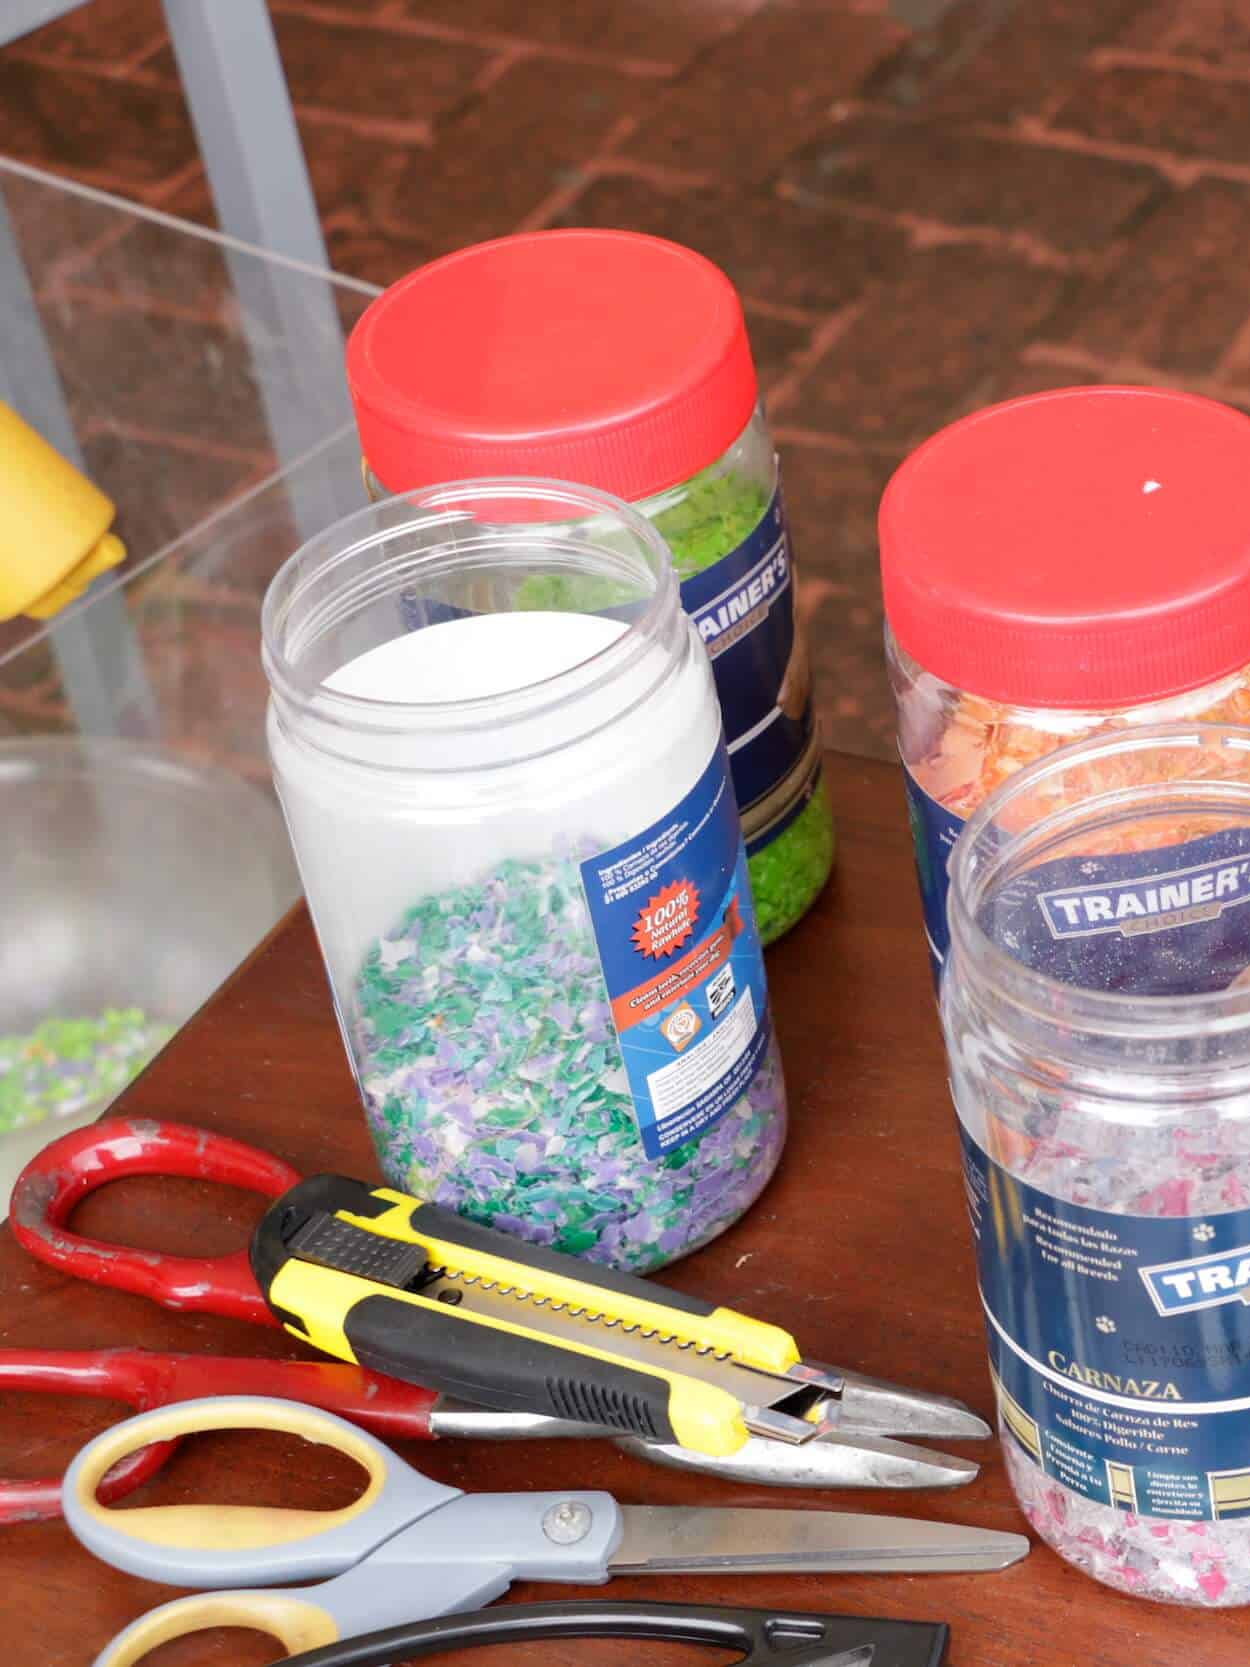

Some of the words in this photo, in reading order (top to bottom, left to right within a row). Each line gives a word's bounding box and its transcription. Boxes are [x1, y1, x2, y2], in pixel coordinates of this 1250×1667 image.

[644, 889, 689, 932] 100%
[651, 908, 688, 941] Natural
[652, 918, 691, 951] Rawhide
[1034, 1207, 1118, 1241] Recomendado
[1036, 1234, 1122, 1270] Recommended
[1077, 1262, 1119, 1281] Breeds
[1048, 1350, 1184, 1401] CARNAZA
[1042, 1380, 1083, 1408] Churro
[1084, 1401, 1100, 1415] de
[1152, 1416, 1171, 1428] de
[1172, 1418, 1199, 1429] Res
[1055, 1412, 1103, 1441] Sabores
[1104, 1433, 1138, 1450] Pollo
[1146, 1443, 1190, 1457] Carne
[1103, 1420, 1166, 1441] Digerible
